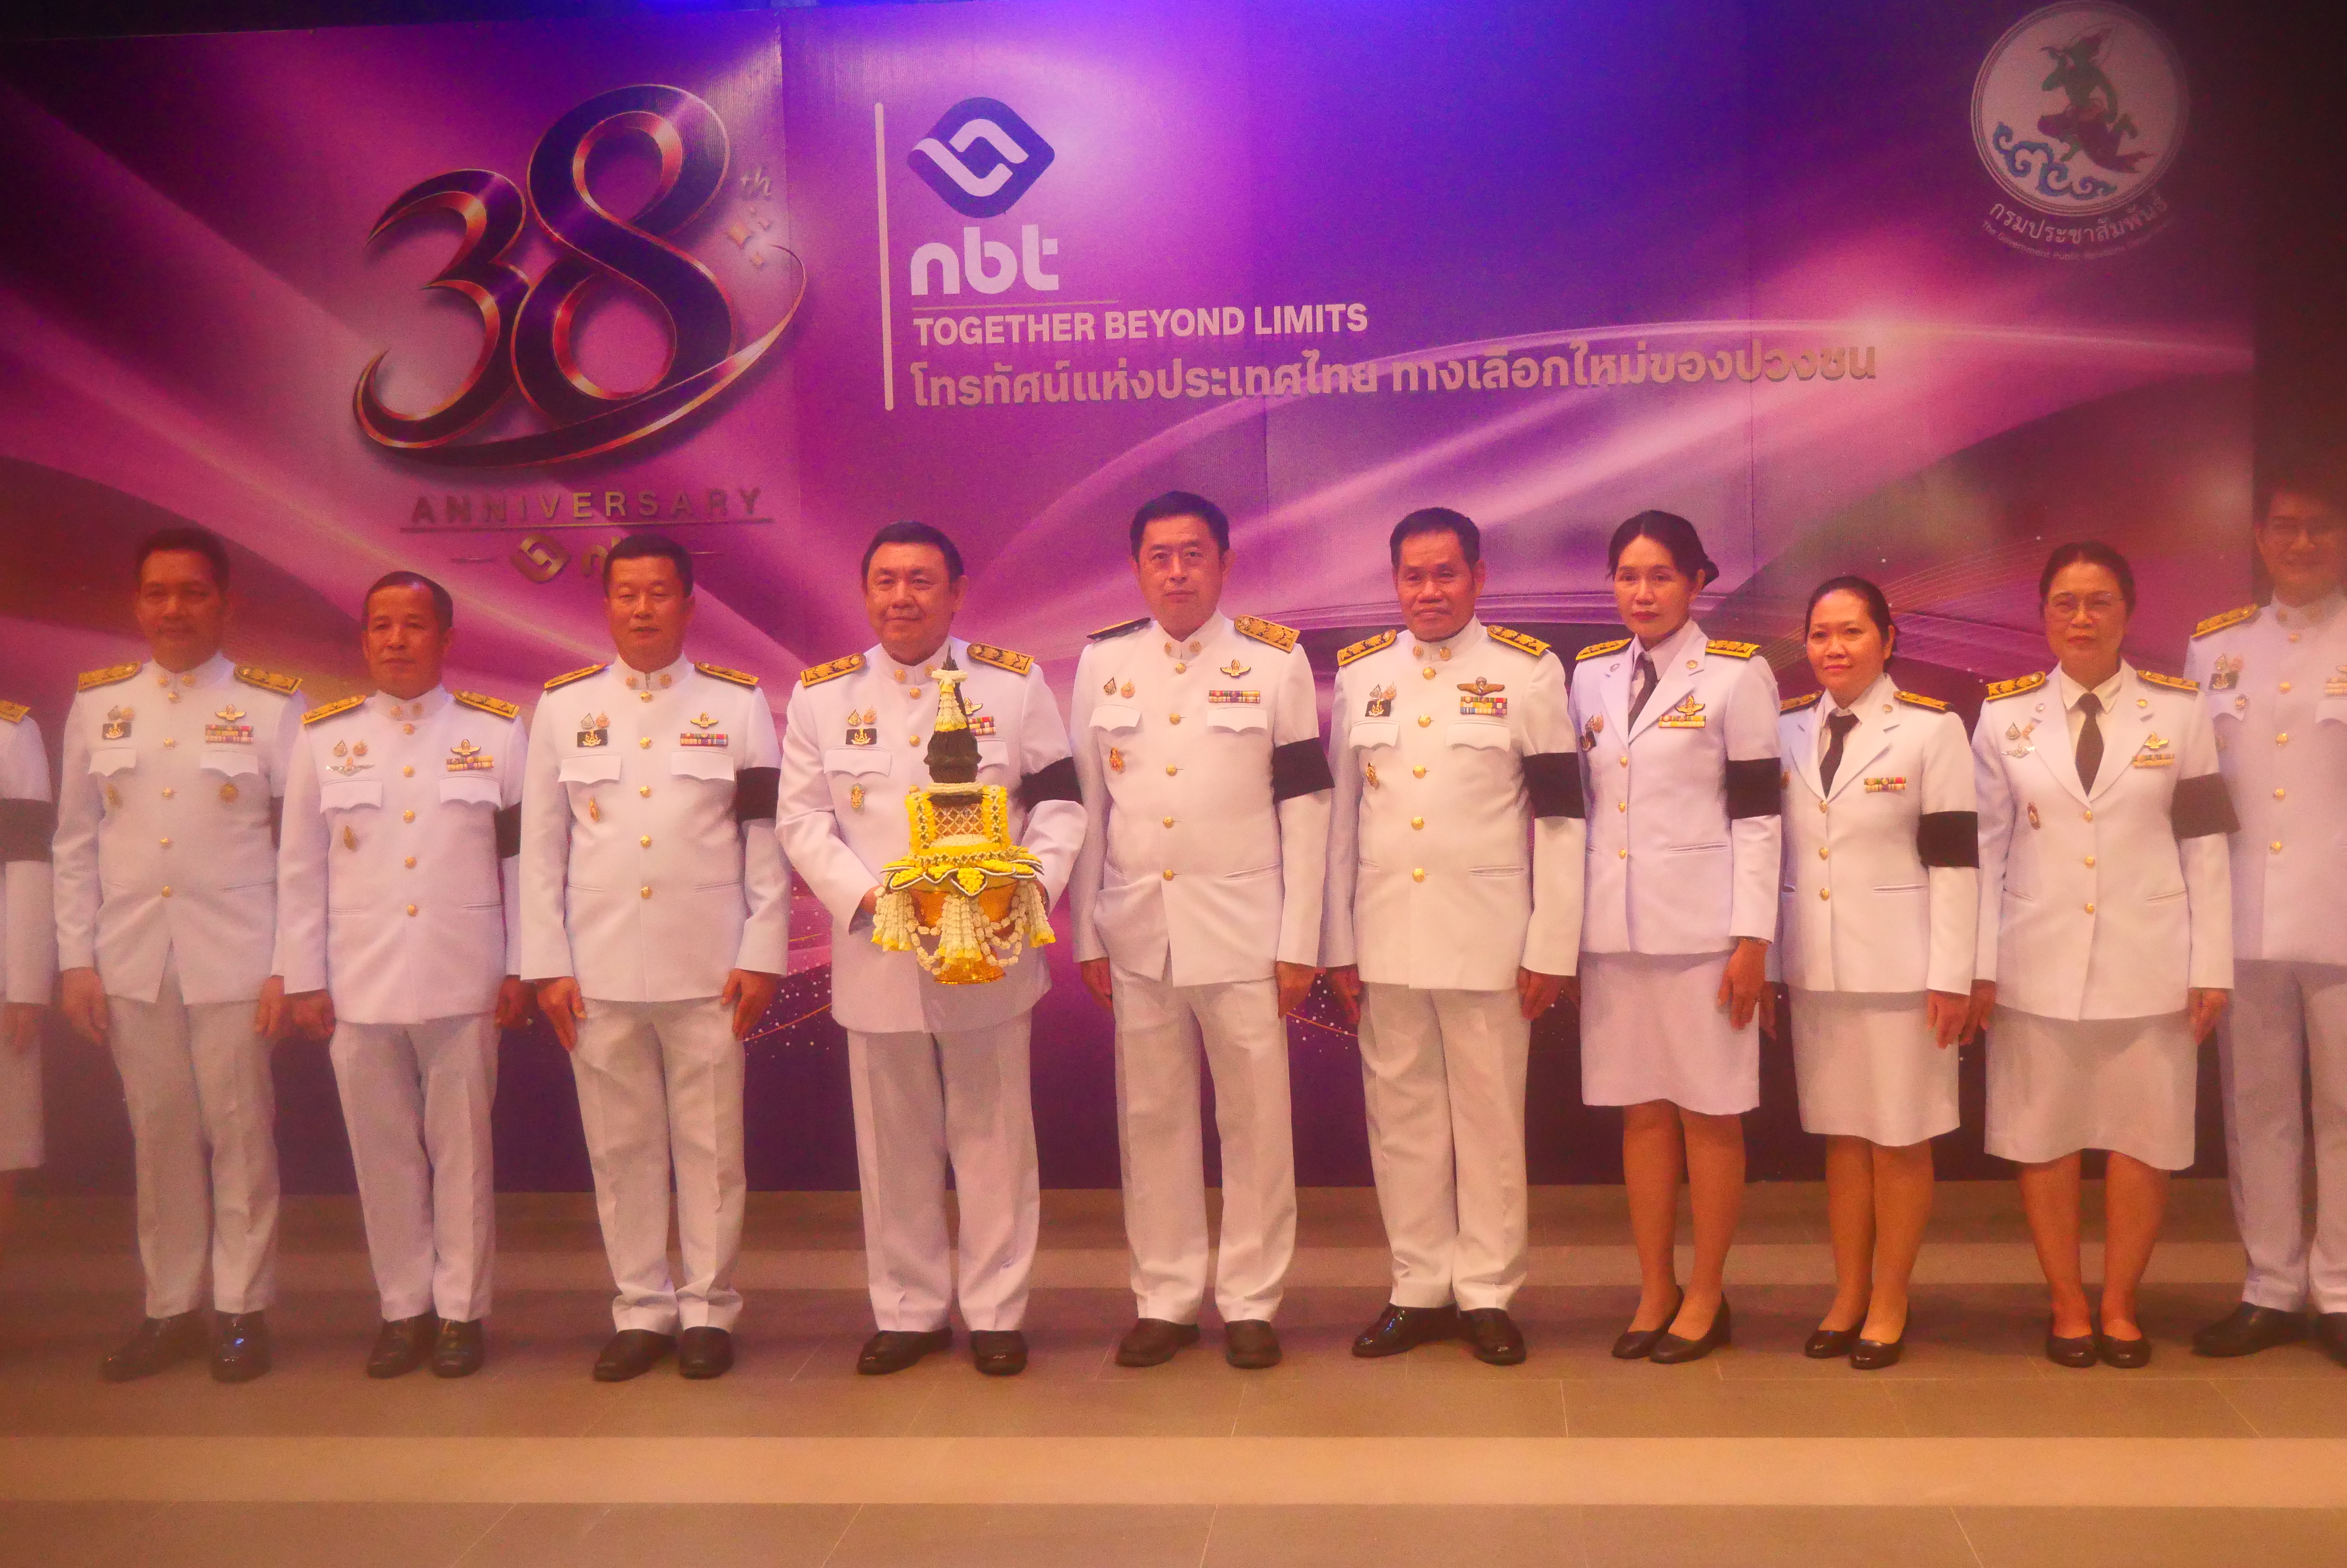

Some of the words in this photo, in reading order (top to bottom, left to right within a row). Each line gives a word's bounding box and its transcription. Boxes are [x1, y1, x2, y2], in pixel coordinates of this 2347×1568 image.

[910, 224, 1059, 295] nbt
[913, 313, 1095, 346] TOGETHER
[1105, 307, 1245, 340] BEYOND
[1254, 303, 1368, 334] LIMITS
[910, 349, 1378, 406] โทรทัศน์แห่งประเทศไทย
[1392, 339, 1876, 392] ทางเลือกใหม่ของปวงชน
[411, 487, 762, 524] ANNIVERSARY
